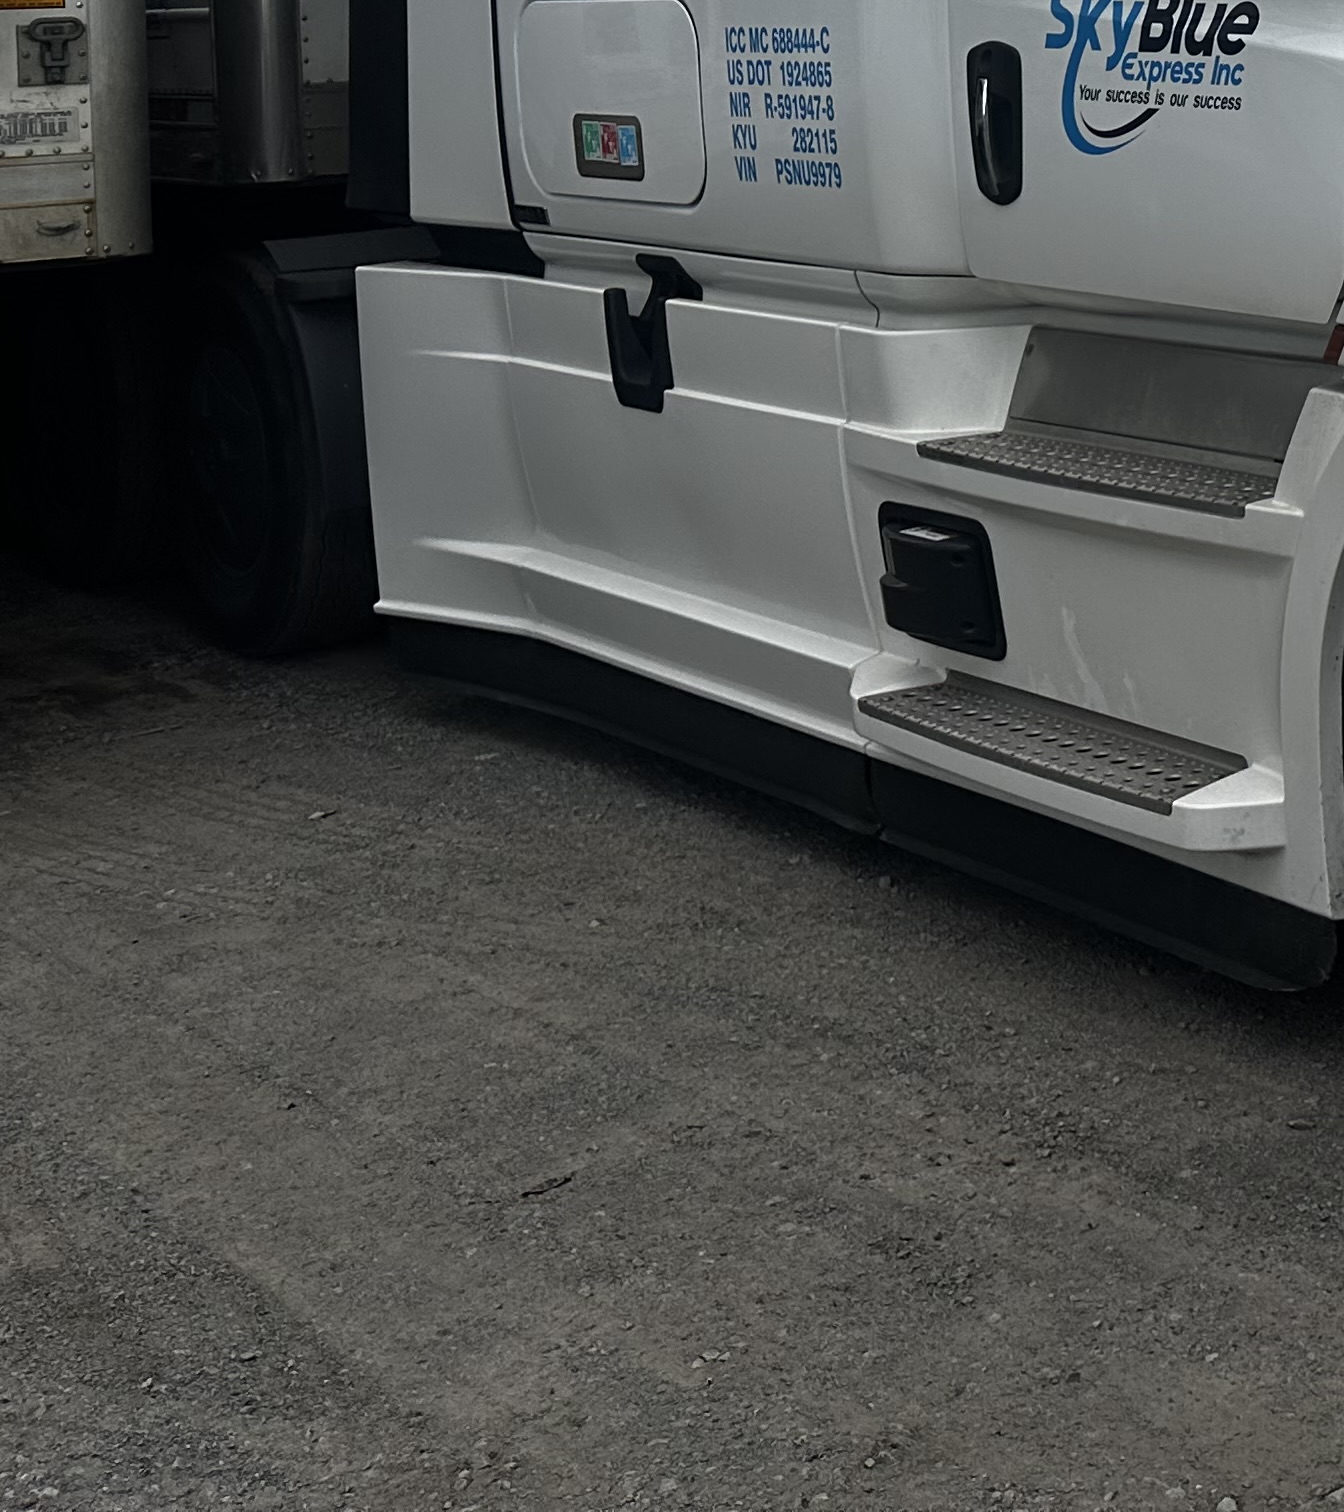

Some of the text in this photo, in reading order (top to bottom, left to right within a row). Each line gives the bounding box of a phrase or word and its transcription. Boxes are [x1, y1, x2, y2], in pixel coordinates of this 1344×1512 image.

[725, 26, 831, 55] ICC MC 688444-C
[726, 59, 833, 88] US DOT 1924865
[1121, 51, 1246, 91] Express Inc
[729, 91, 836, 122] NIR R-591947-8
[1079, 84, 1243, 111] Your success is our success
[732, 124, 839, 155] KYU 282115
[734, 155, 843, 190] VIN PSNU9979
